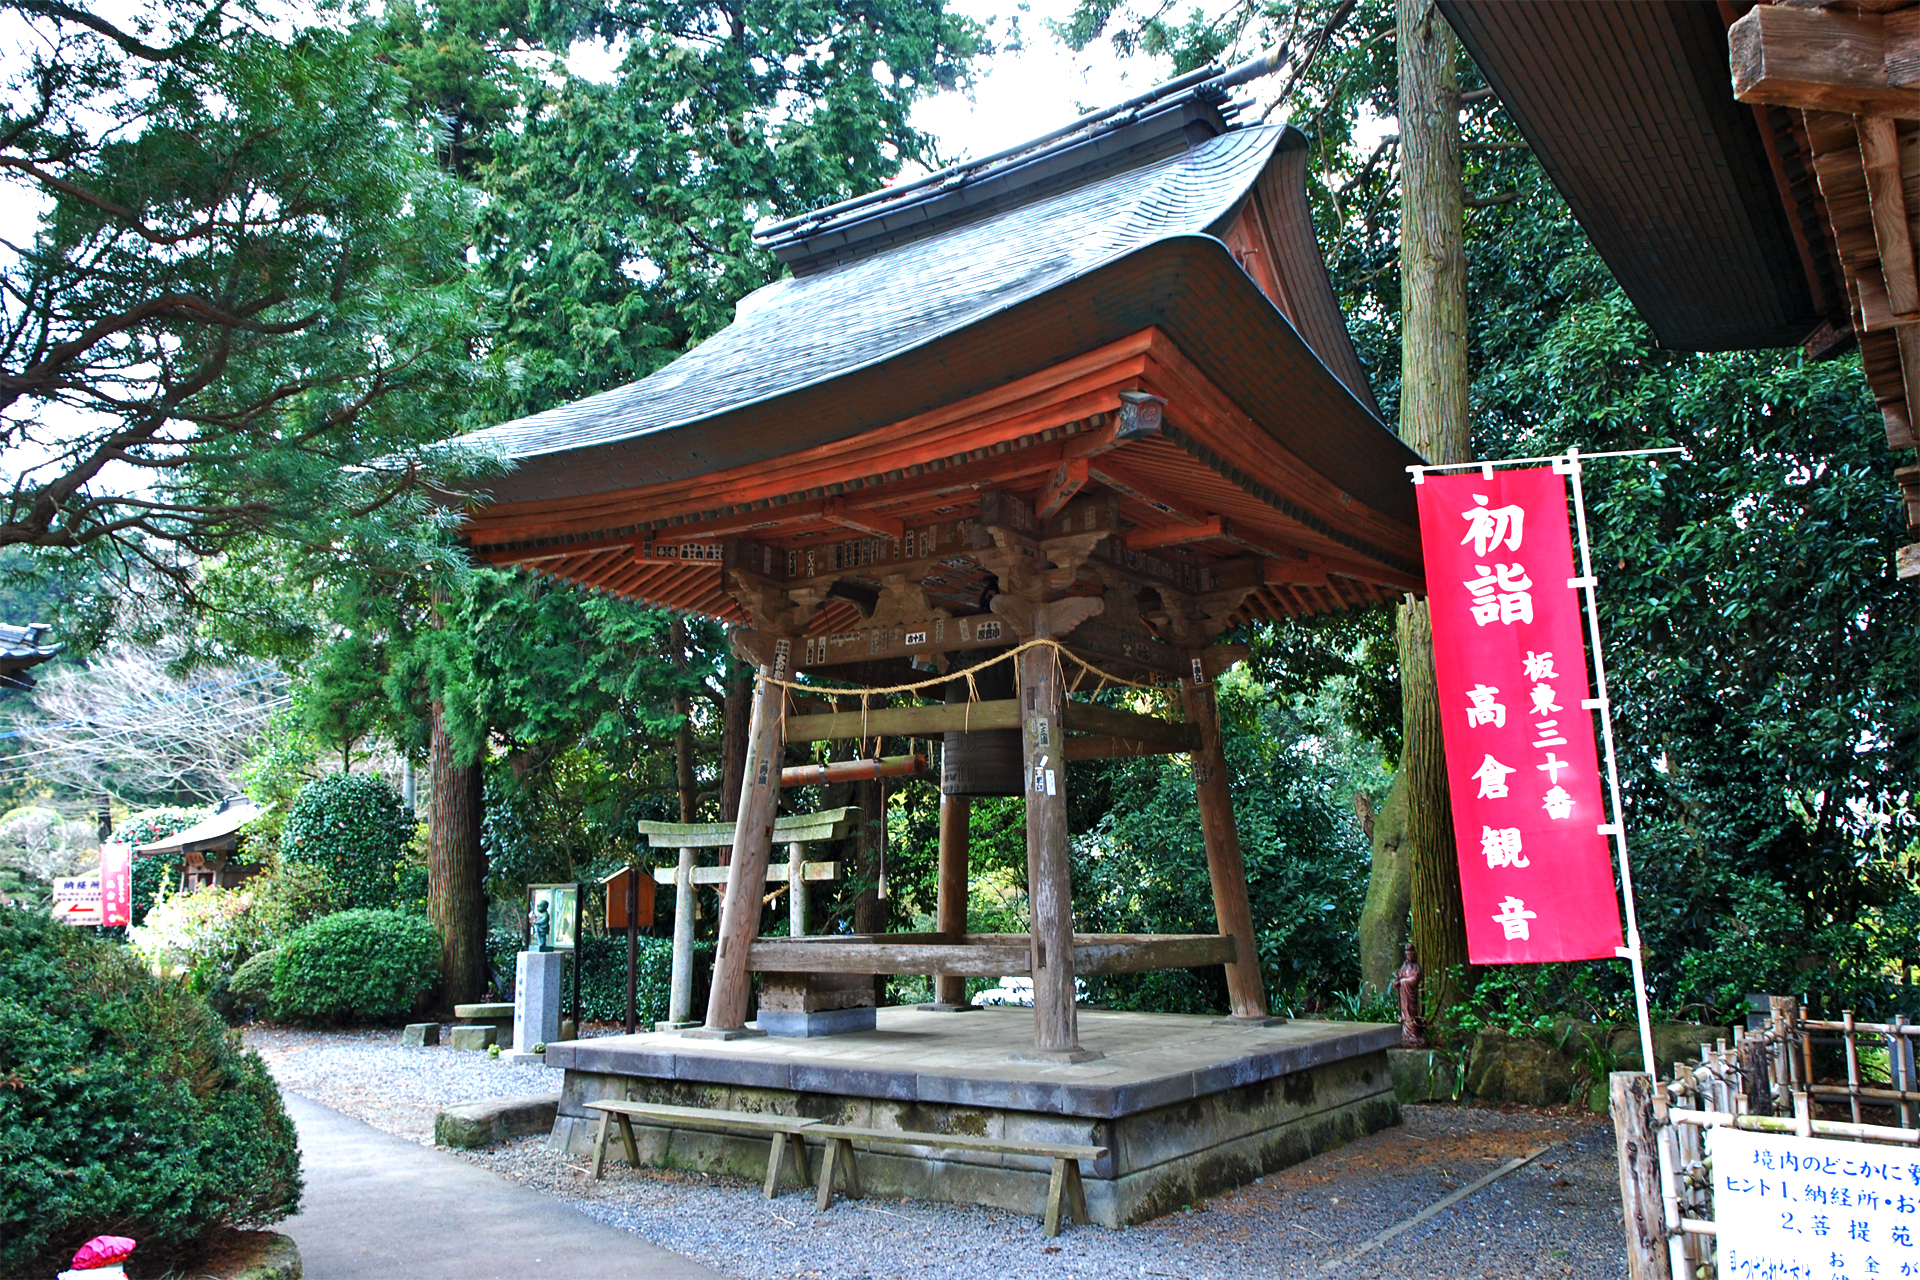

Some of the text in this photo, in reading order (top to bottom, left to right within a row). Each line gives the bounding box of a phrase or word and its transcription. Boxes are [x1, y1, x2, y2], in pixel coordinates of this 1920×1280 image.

[1460, 494, 1534, 627] 初詣
[1522, 650, 1576, 821] 板東三十番
[1465, 684, 1538, 942] 高倉観音
[1726, 1176, 1771, 1197] ヒント
